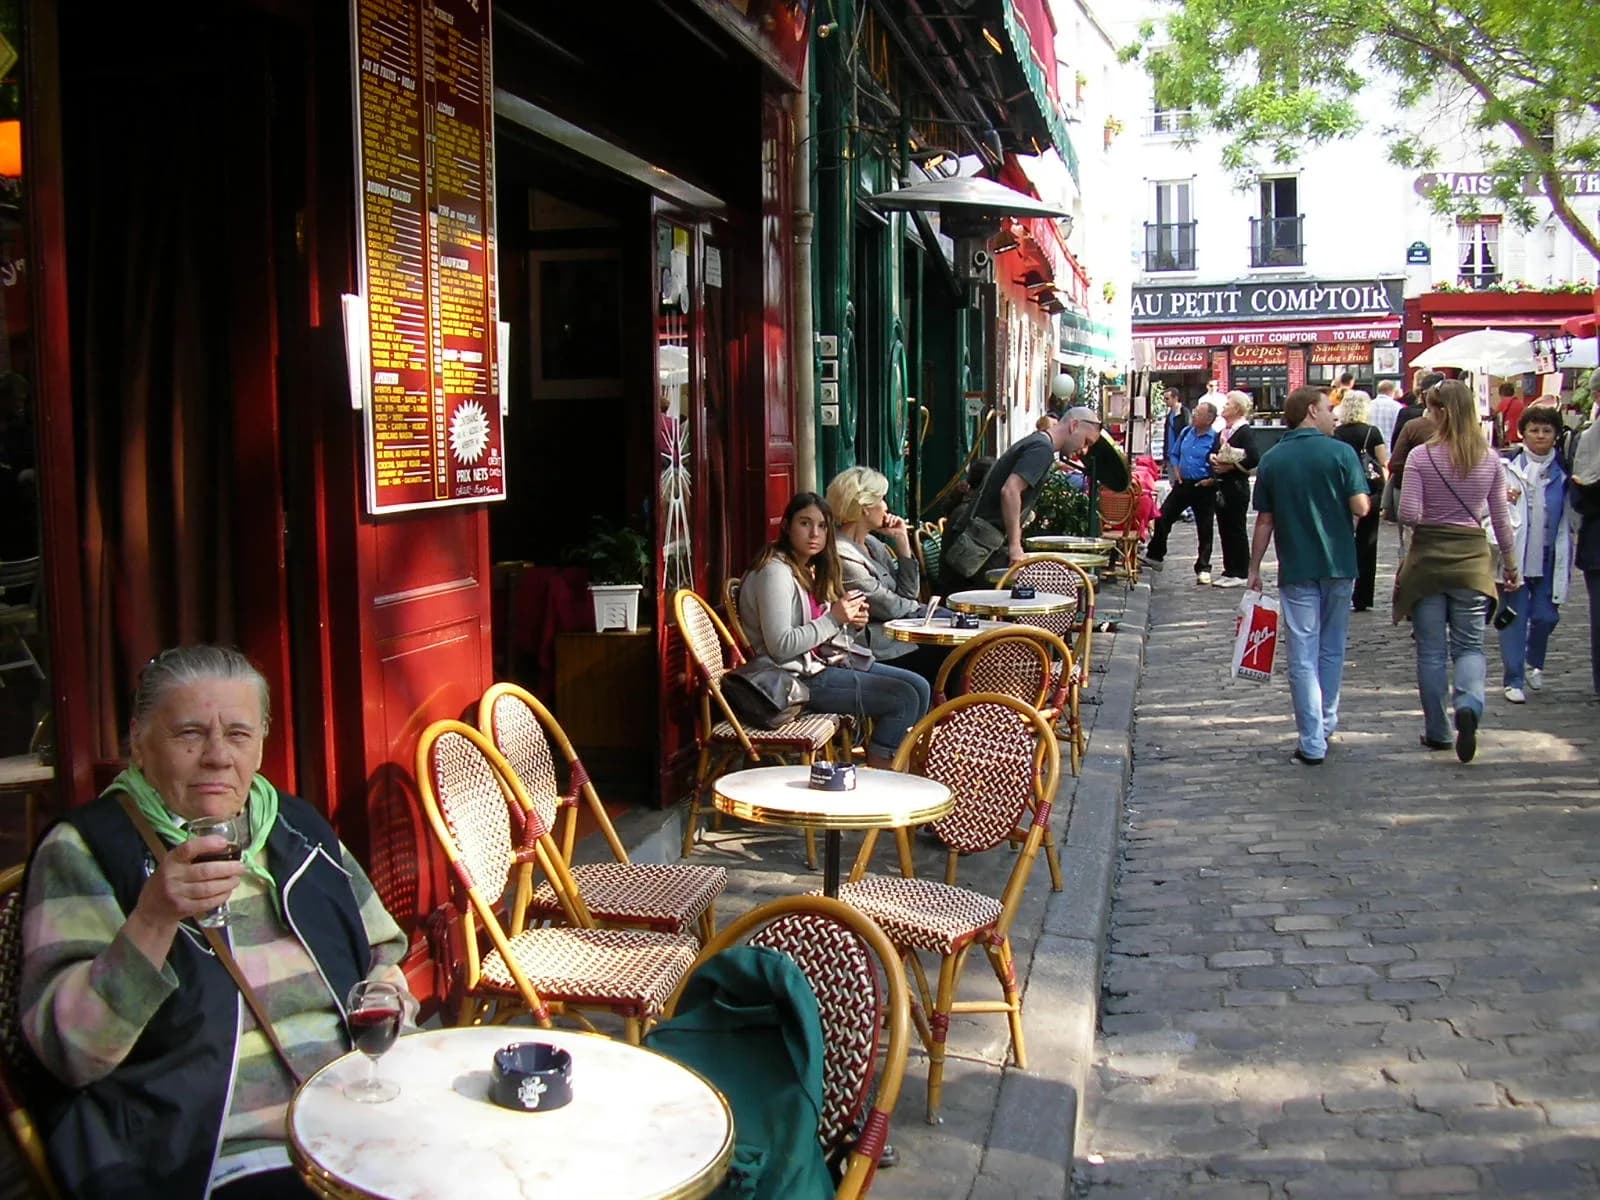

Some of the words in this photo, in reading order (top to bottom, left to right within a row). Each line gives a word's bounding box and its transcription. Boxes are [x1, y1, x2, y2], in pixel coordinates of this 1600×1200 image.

[1435, 173, 1523, 194] MAIS
[1130, 292, 1163, 316] AU
[1170, 290, 1242, 315] PETIT
[1251, 284, 1390, 312] COMPTOIR
[1220, 335, 1234, 344] AU
[1238, 334, 1265, 344] PETIT
[1269, 332, 1317, 342] COMPTOIR
[1332, 331, 1344, 340] TO
[1345, 331, 1367, 340] TAKE
[1367, 330, 1392, 339] AWAY
[1156, 349, 1203, 362] Glaces
[1311, 354, 1327, 363] Hot
[472, 467, 489, 481] NETS
